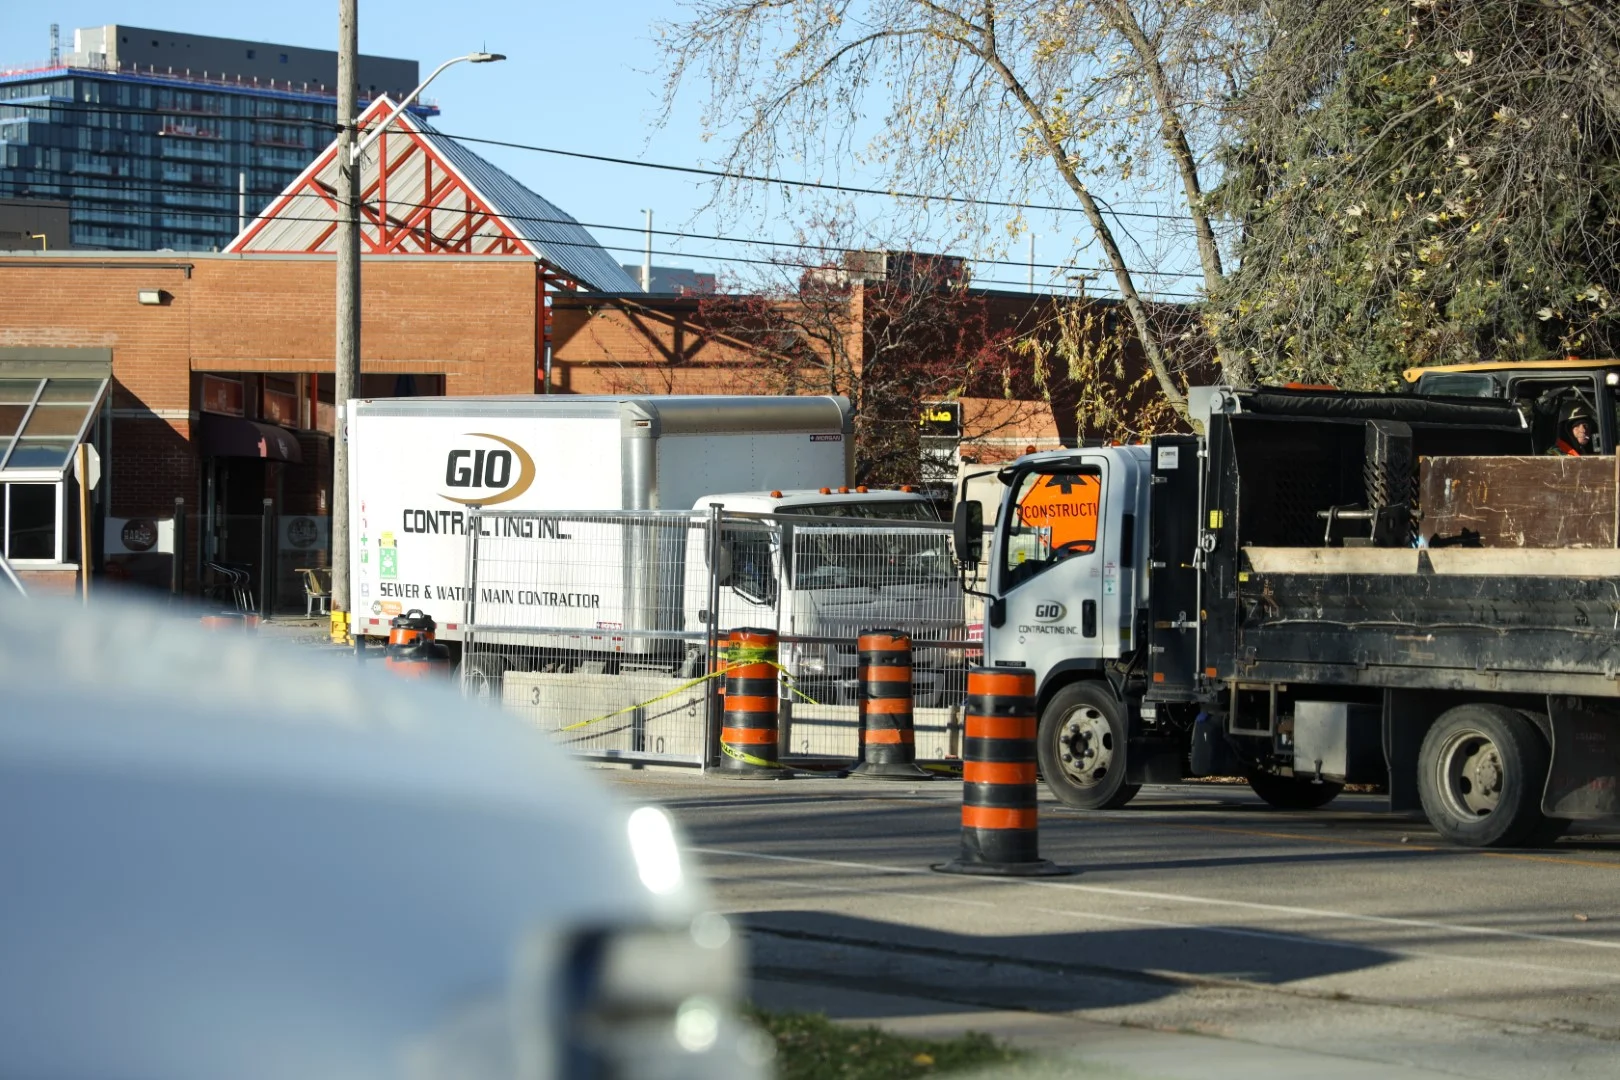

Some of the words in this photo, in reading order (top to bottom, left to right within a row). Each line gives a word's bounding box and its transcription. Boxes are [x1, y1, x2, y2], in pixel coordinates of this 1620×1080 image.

[446, 449, 512, 488] GIO
[380, 582, 419, 598] SEWER
[424, 585, 432, 599] &
[481, 588, 514, 604] MAIN
[518, 590, 600, 609] CONTRACTOR
[1035, 604, 1060, 618] GIO
[1019, 625, 1065, 634] CONTRACTING
[531, 686, 541, 706] 3
